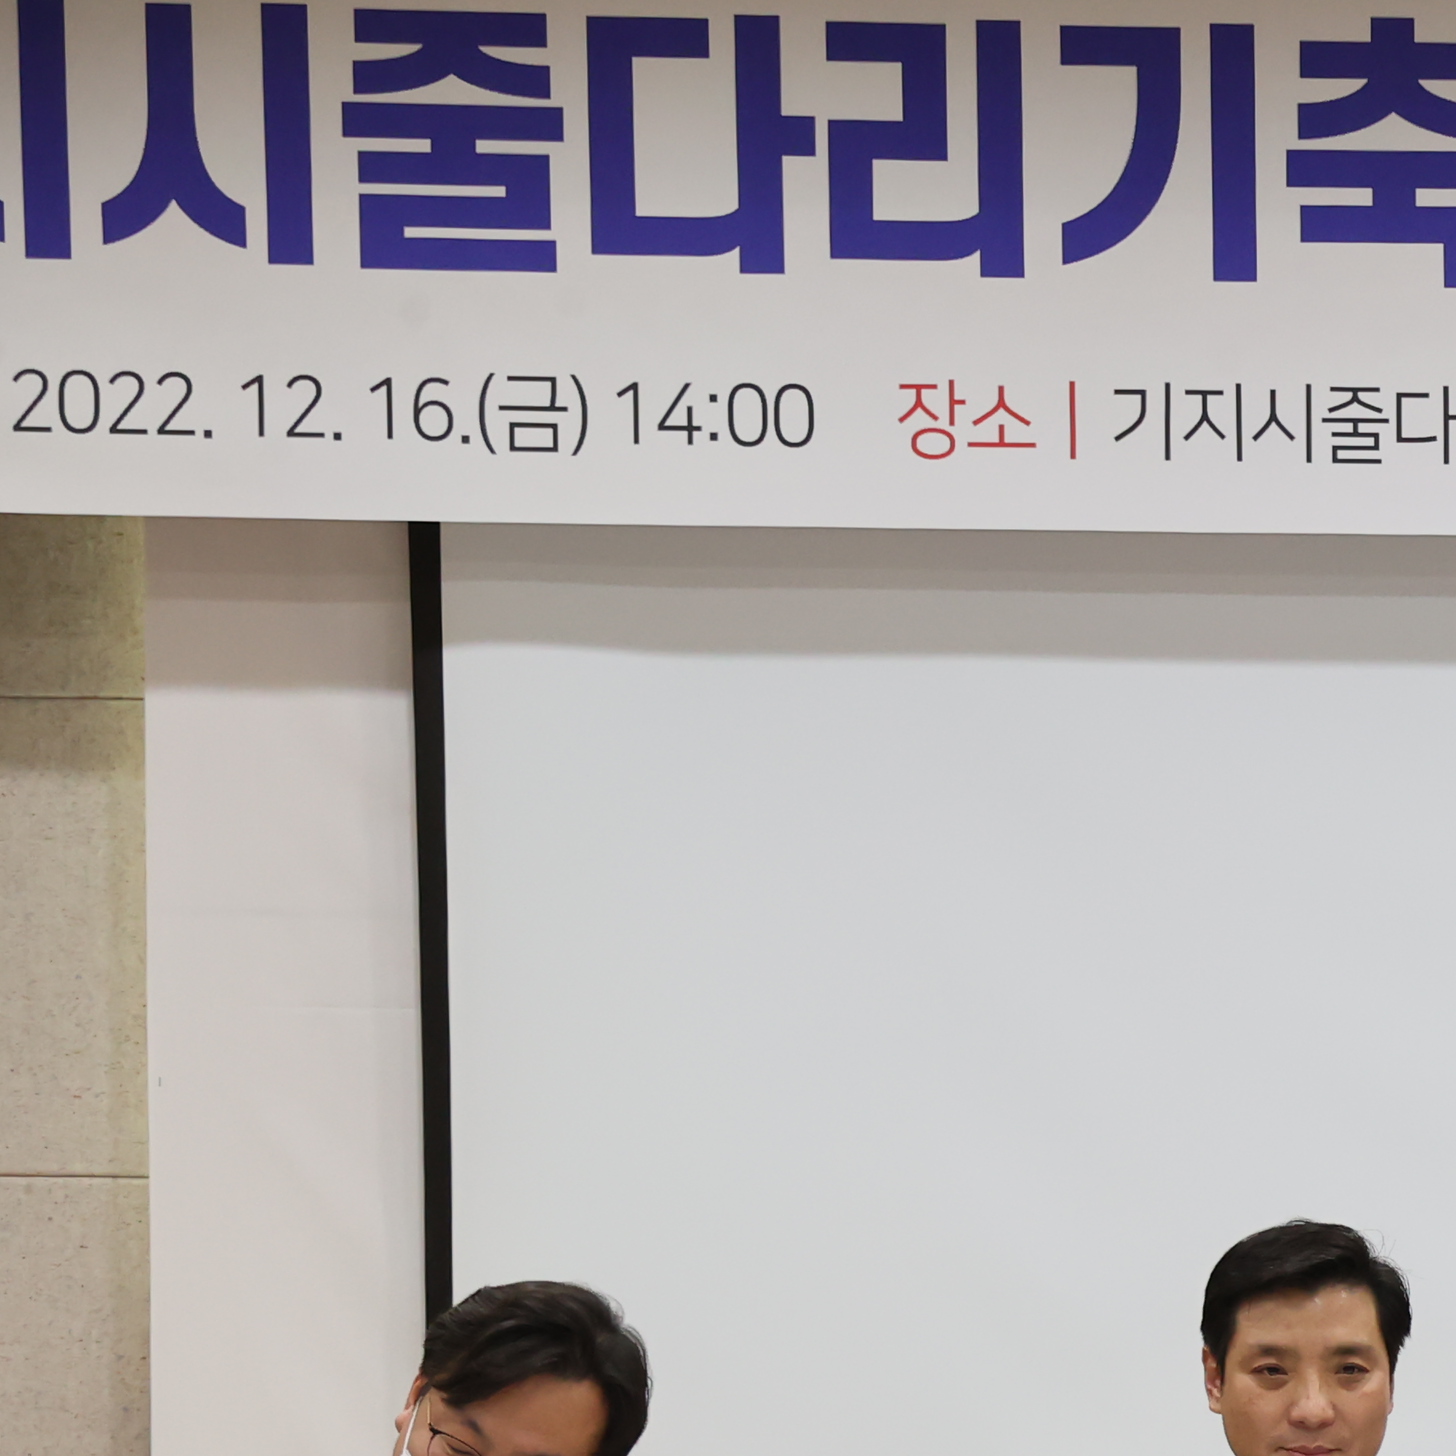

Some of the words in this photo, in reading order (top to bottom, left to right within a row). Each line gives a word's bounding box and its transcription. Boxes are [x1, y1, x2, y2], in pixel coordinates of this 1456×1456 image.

[13, 369, 212, 438] 2022.
[241, 375, 341, 440] 12.
[370, 373, 587, 456] 16.(금)
[617, 382, 814, 447] 14:00
[900, 381, 1036, 459] 장소
